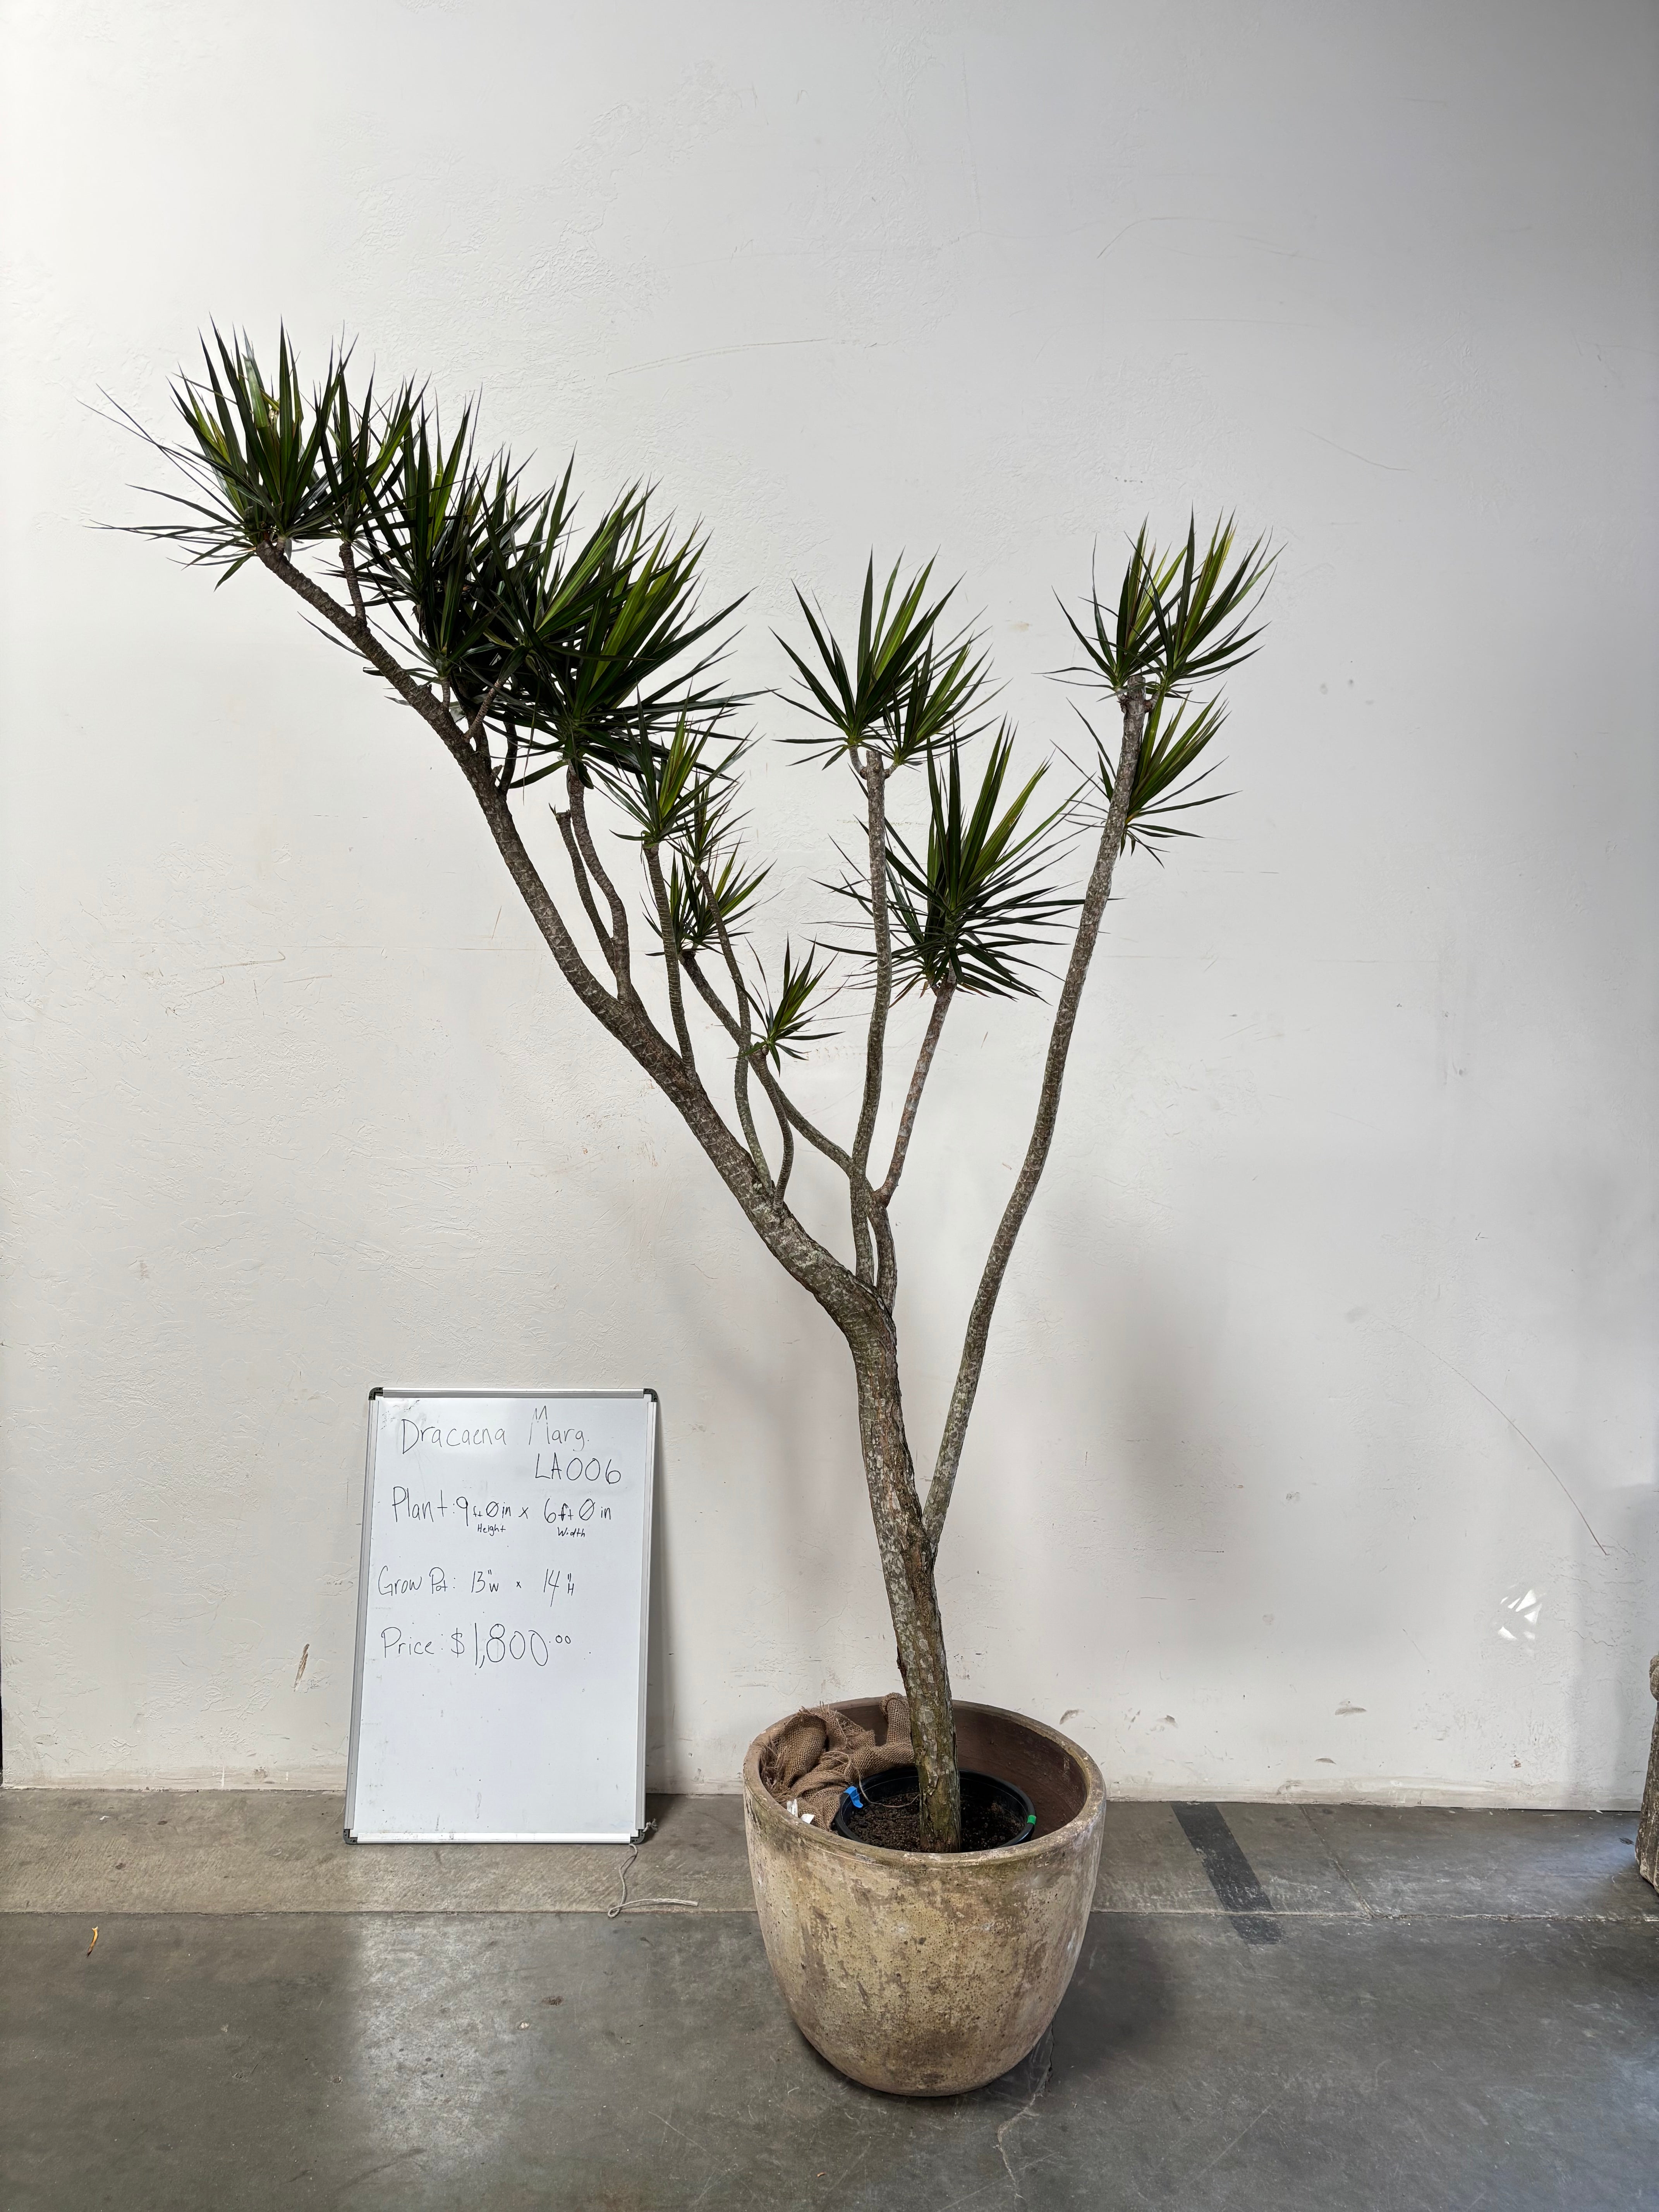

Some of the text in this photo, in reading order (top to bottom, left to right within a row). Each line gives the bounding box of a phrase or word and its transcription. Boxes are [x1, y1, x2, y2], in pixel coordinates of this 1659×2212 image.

[401, 1419, 507, 1454] Dracaena
[535, 1452, 621, 1484] LA006
[392, 1486, 455, 1522] Plant:
[477, 1523, 506, 1536] Height
[557, 1527, 586, 1537] Width
[378, 1566, 422, 1596] Grow
[429, 1567, 456, 1594] Pot:
[381, 1627, 443, 1658] Price:
